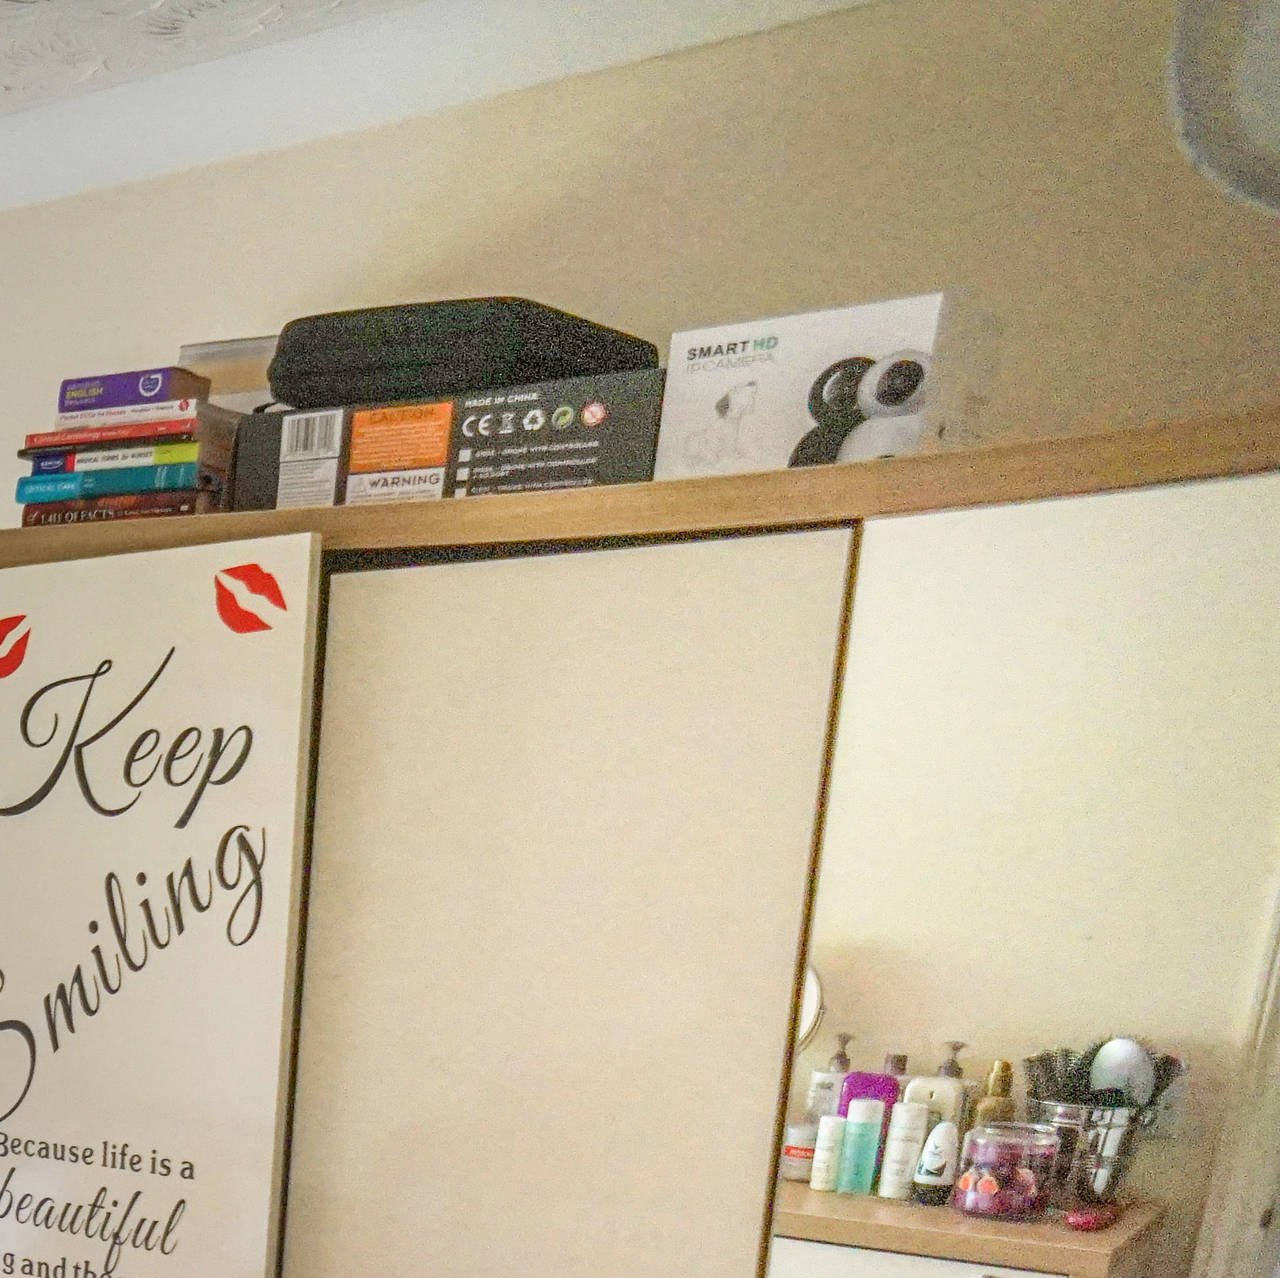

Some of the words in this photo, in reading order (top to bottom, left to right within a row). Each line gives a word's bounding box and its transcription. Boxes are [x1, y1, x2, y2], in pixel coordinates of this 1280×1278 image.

[687, 340, 750, 360] SMART
[753, 336, 778, 351] HD
[369, 473, 440, 488] WARNING
[101, 1140, 142, 1173] life
[149, 1149, 172, 1177] is
[180, 1160, 195, 1180] a
